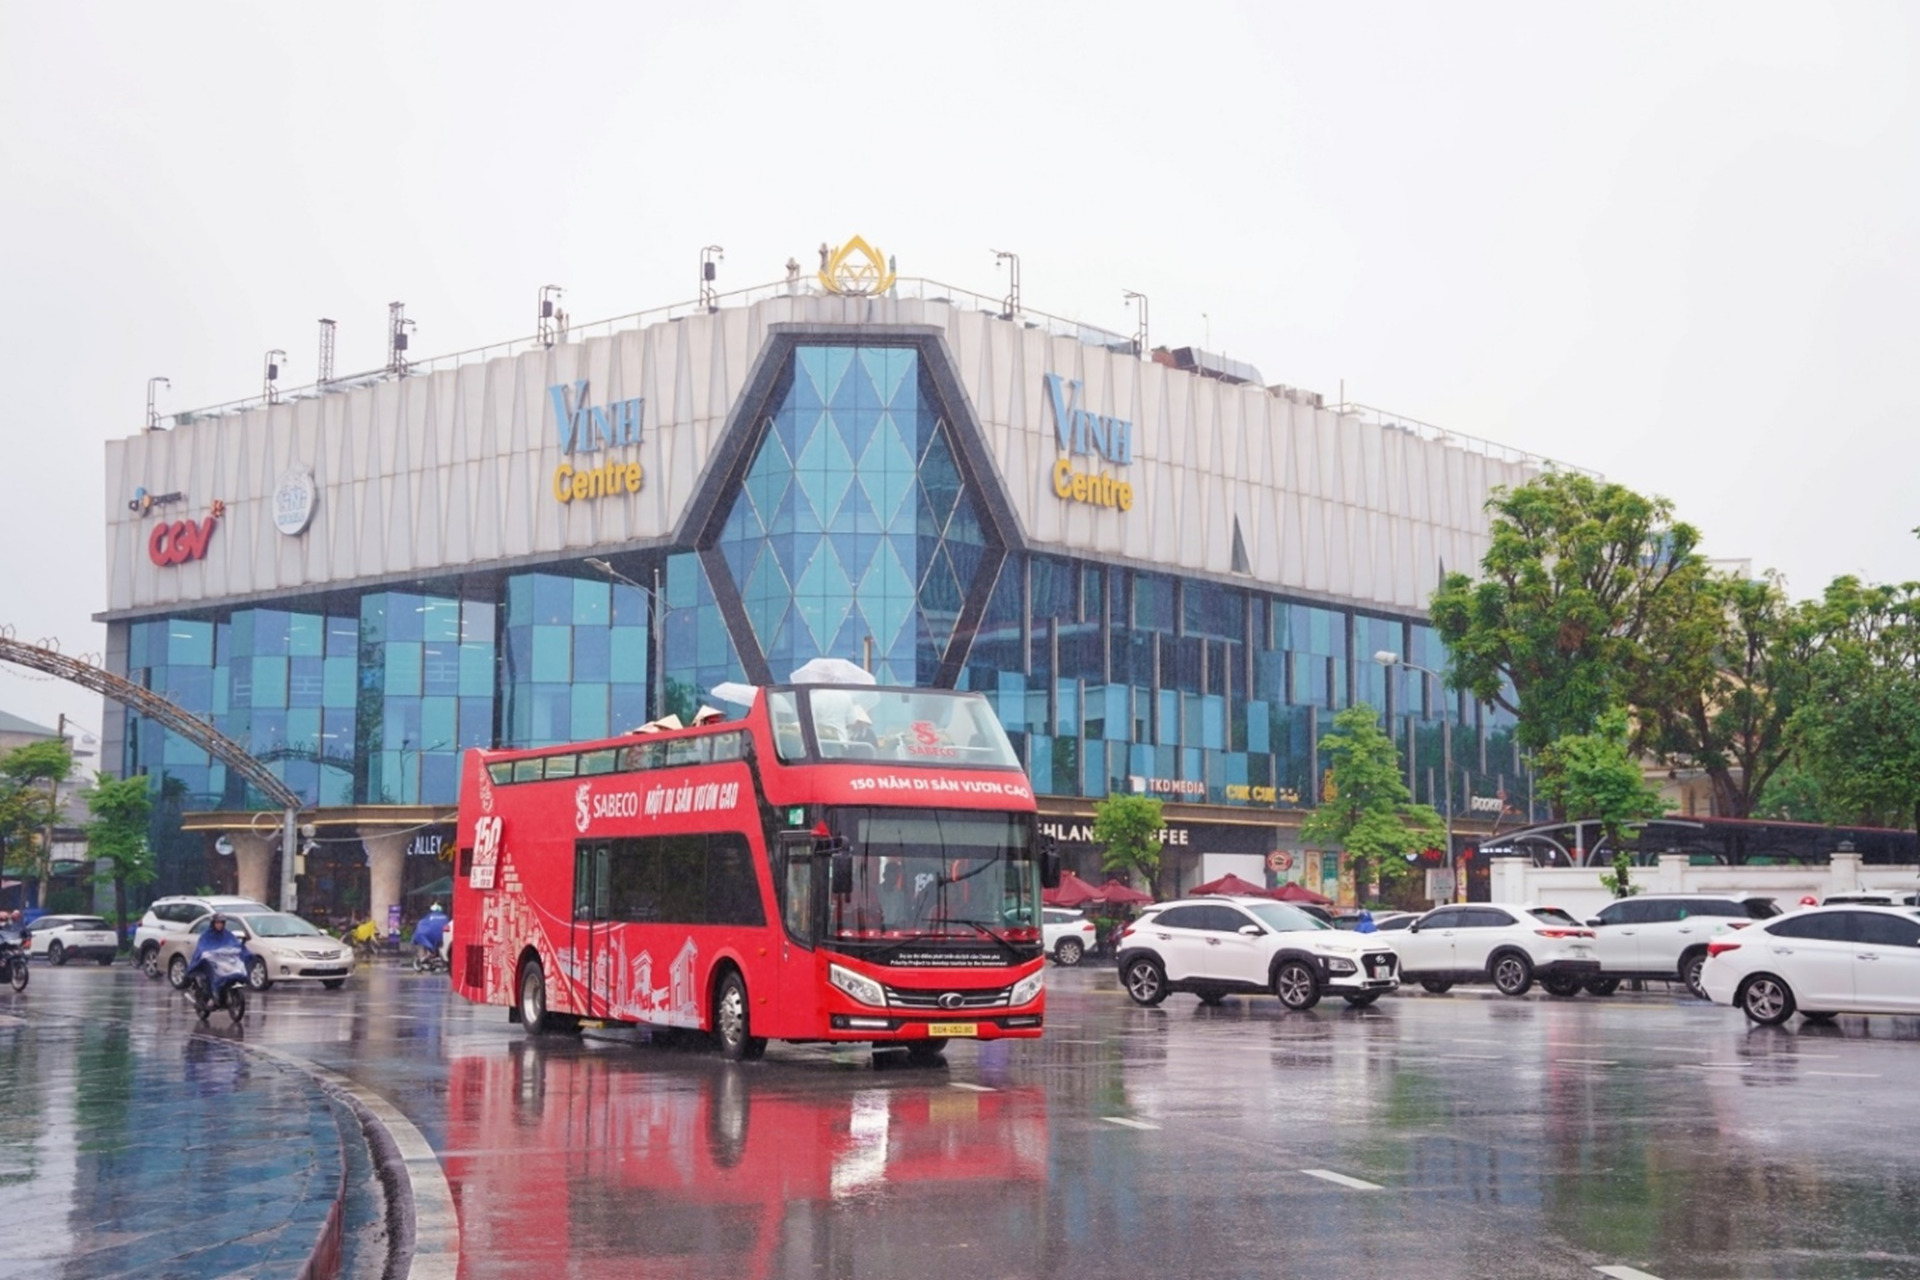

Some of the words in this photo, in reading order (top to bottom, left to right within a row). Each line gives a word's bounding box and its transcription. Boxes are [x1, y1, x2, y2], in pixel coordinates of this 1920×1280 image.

[548, 379, 645, 455] VINH
[1044, 372, 1133, 465] VINH
[553, 457, 643, 504] Centre
[1053, 458, 1133, 512] Centre
[149, 516, 215, 566] CGV
[593, 791, 638, 818] SABECO
[664, 788, 676, 814] DI
[719, 781, 739, 810] CAO
[850, 778, 875, 790] 150
[877, 775, 911, 789] NĂM
[913, 779, 928, 790] DI
[1004, 783, 1030, 799] CAO
[1149, 778, 1171, 793] TKD
[1171, 780, 1205, 795] MEDIA
[414, 835, 442, 855] ALLEY
